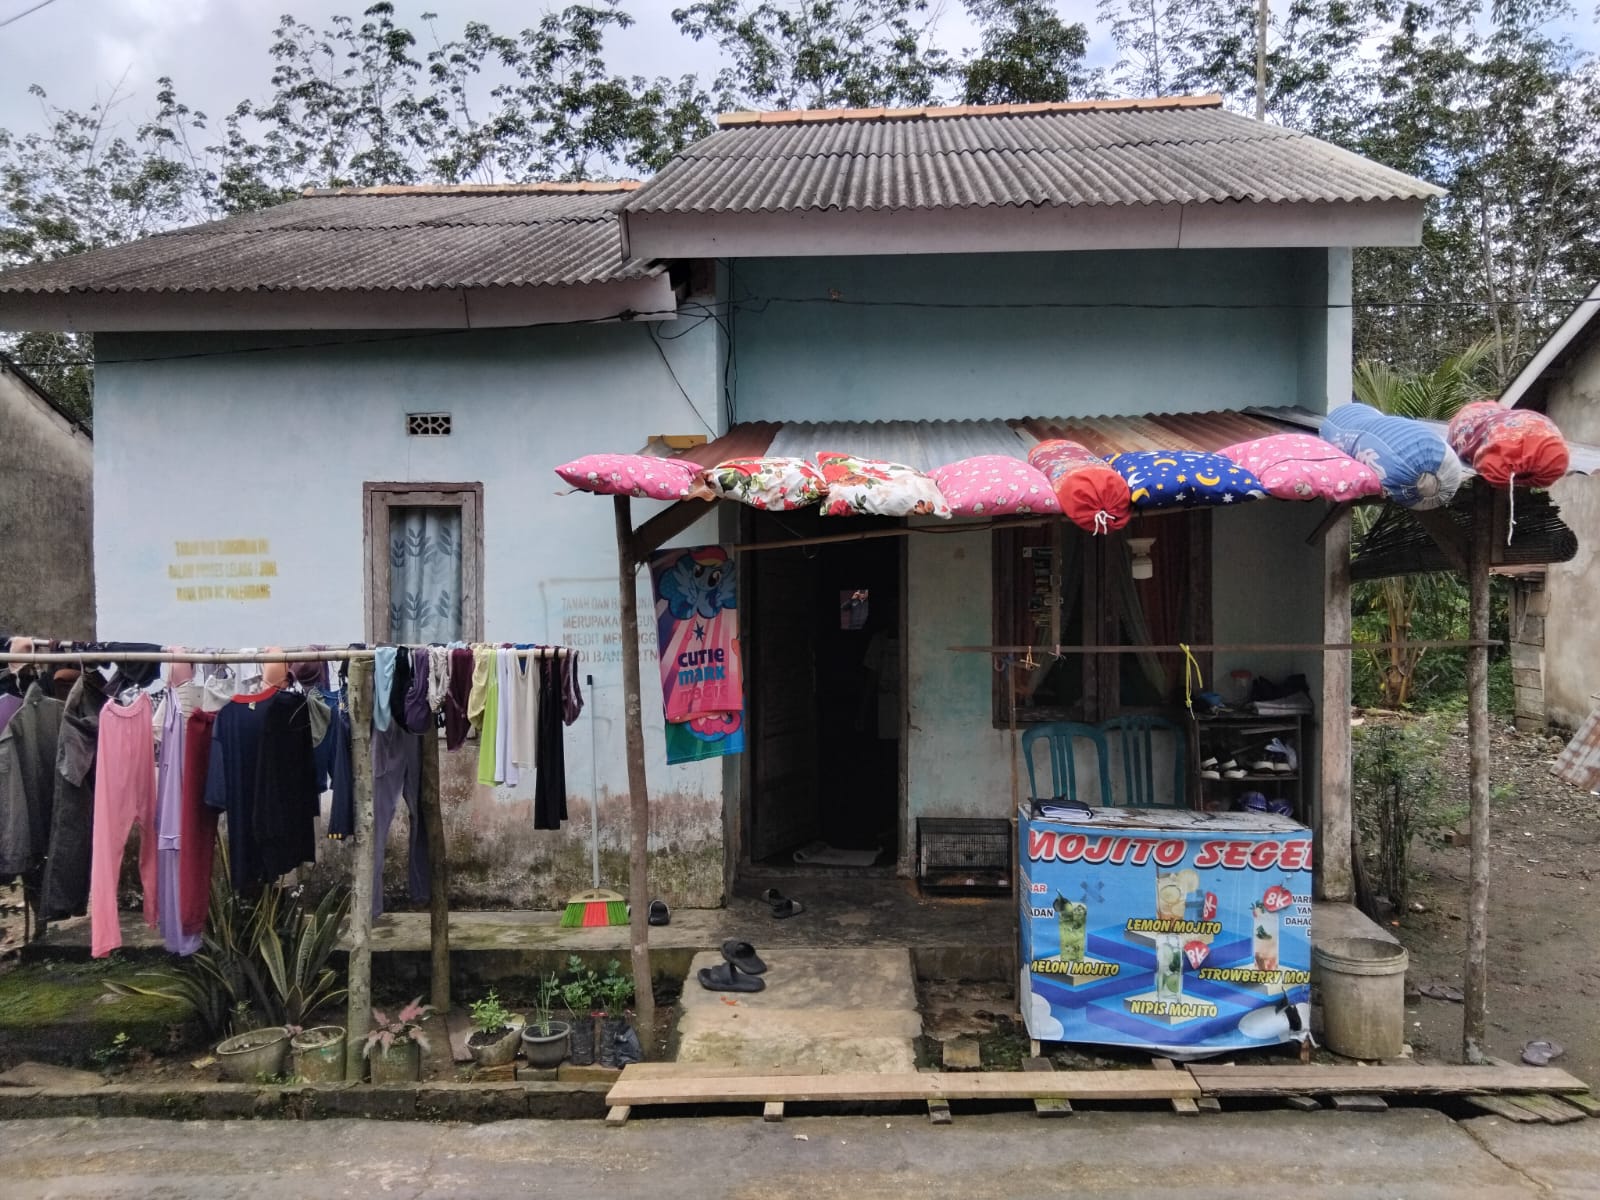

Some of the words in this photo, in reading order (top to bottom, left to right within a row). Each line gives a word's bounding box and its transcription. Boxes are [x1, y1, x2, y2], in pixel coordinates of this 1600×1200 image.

[563, 615, 621, 629] MERUPAKA
[594, 650, 622, 663] BAN
[1028, 828, 1188, 867] MOJITO
[1265, 892, 1288, 909] 8K
[1126, 918, 1170, 933] LEMON
[1172, 920, 1222, 935] MOJITO
[1071, 961, 1120, 976] MOJITO
[1199, 968, 1281, 984] STROWBERRY
[1130, 1001, 1167, 1016] NIPIS
[1168, 1003, 1218, 1018] MOJITO
